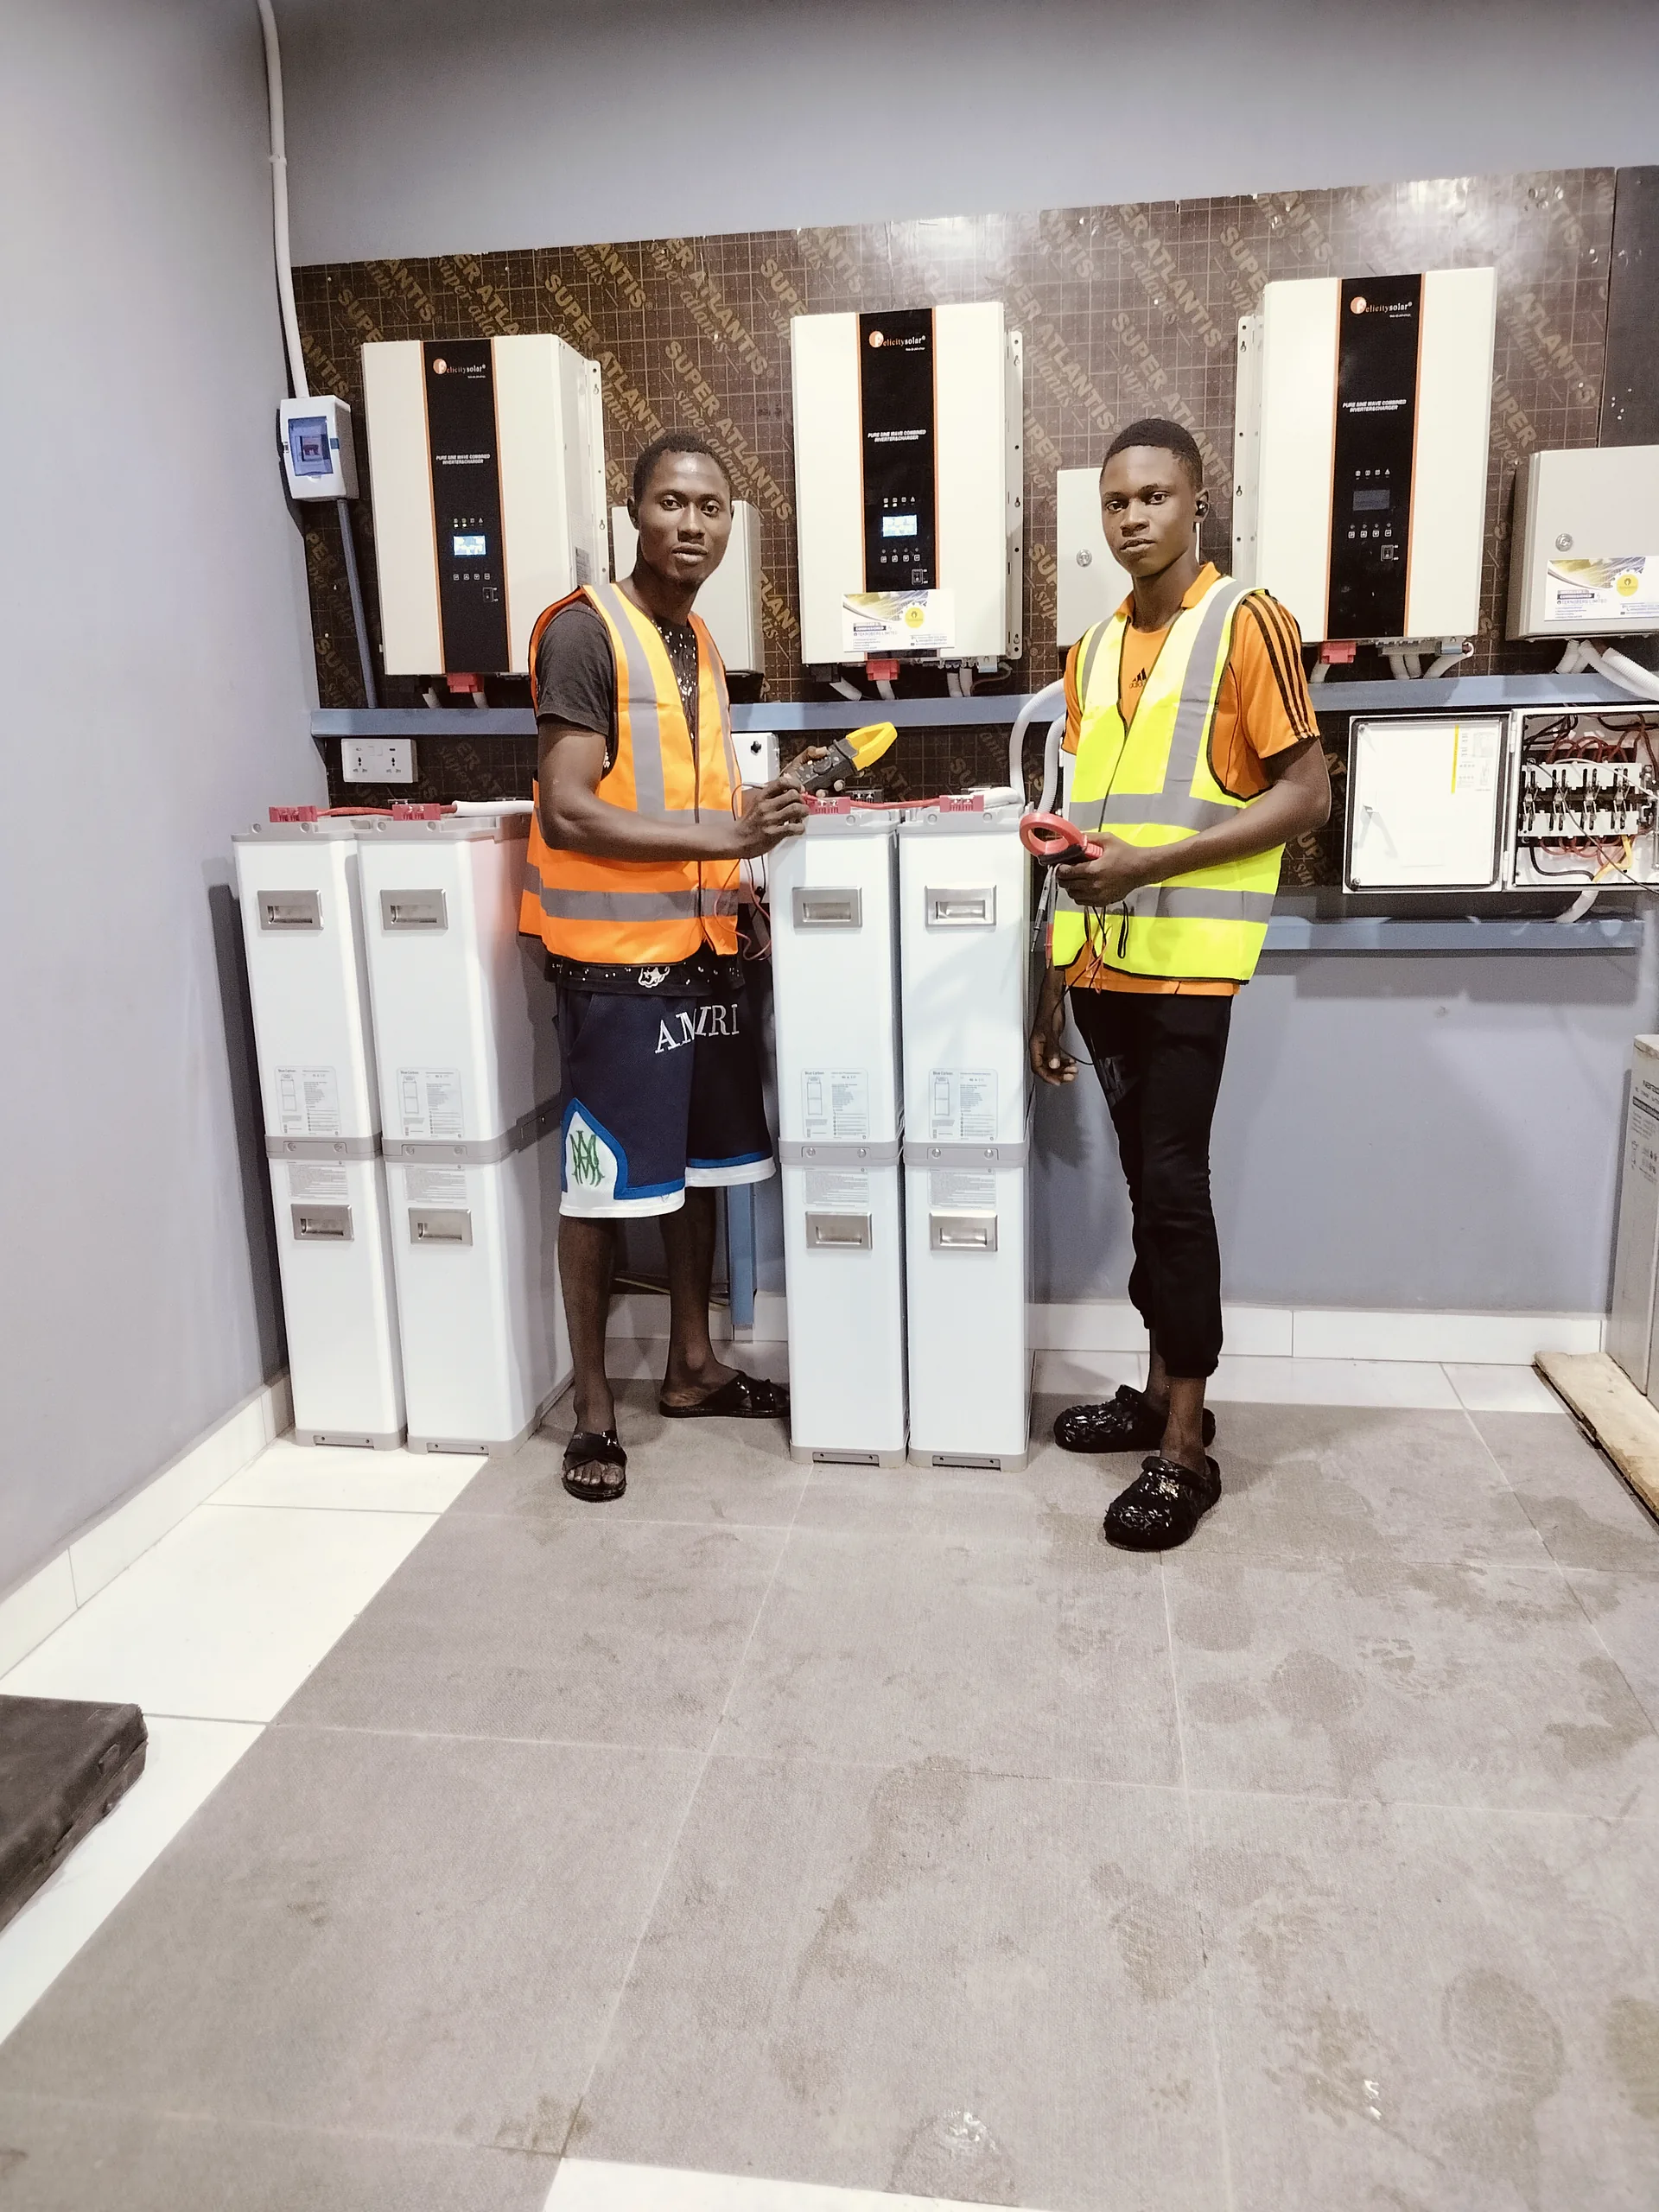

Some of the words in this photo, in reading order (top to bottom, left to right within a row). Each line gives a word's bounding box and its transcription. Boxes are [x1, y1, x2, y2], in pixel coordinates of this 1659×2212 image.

[338, 289, 384, 342] SUPE
[689, 270, 768, 376] ATLANTIS
[761, 258, 808, 317] SUPE
[1141, 238, 1222, 347] ATLANTIS
[545, 274, 601, 350] SUPER
[597, 351, 667, 447] ATLANTI
[1038, 322, 1115, 430] ATLANTIS
[1112, 312, 1166, 391] SUPER
[665, 340, 720, 416] SUPER
[716, 417, 792, 520] ATLANTIS
[675, 390, 710, 435] super
